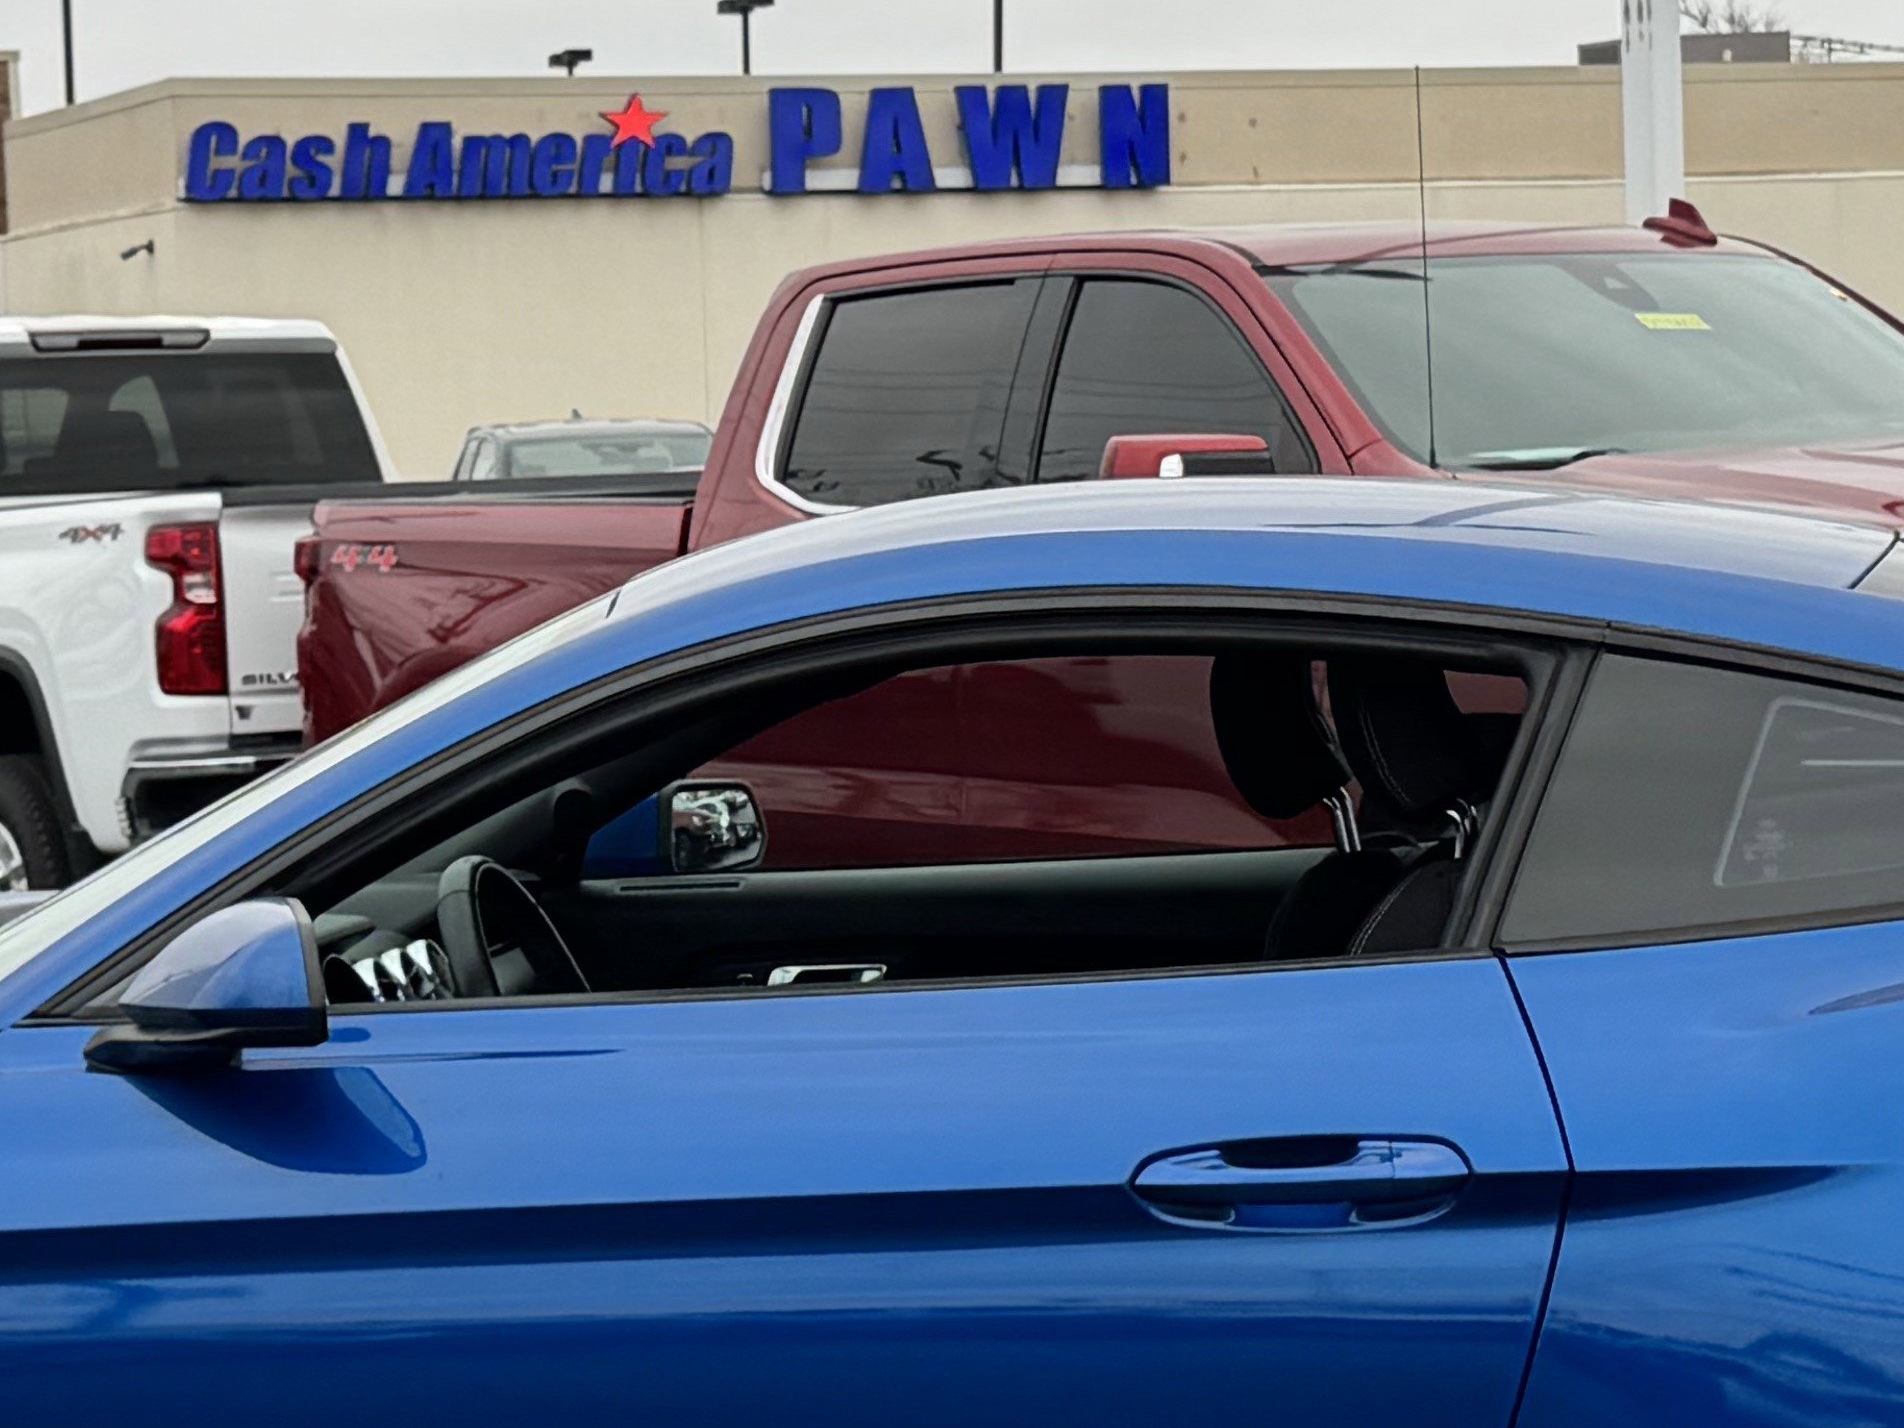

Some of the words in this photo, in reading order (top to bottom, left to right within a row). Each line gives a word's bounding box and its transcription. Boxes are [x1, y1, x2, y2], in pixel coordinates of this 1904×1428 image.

[185, 120, 392, 201] Cash
[402, 120, 734, 200] America
[768, 83, 1172, 195] PAWN
